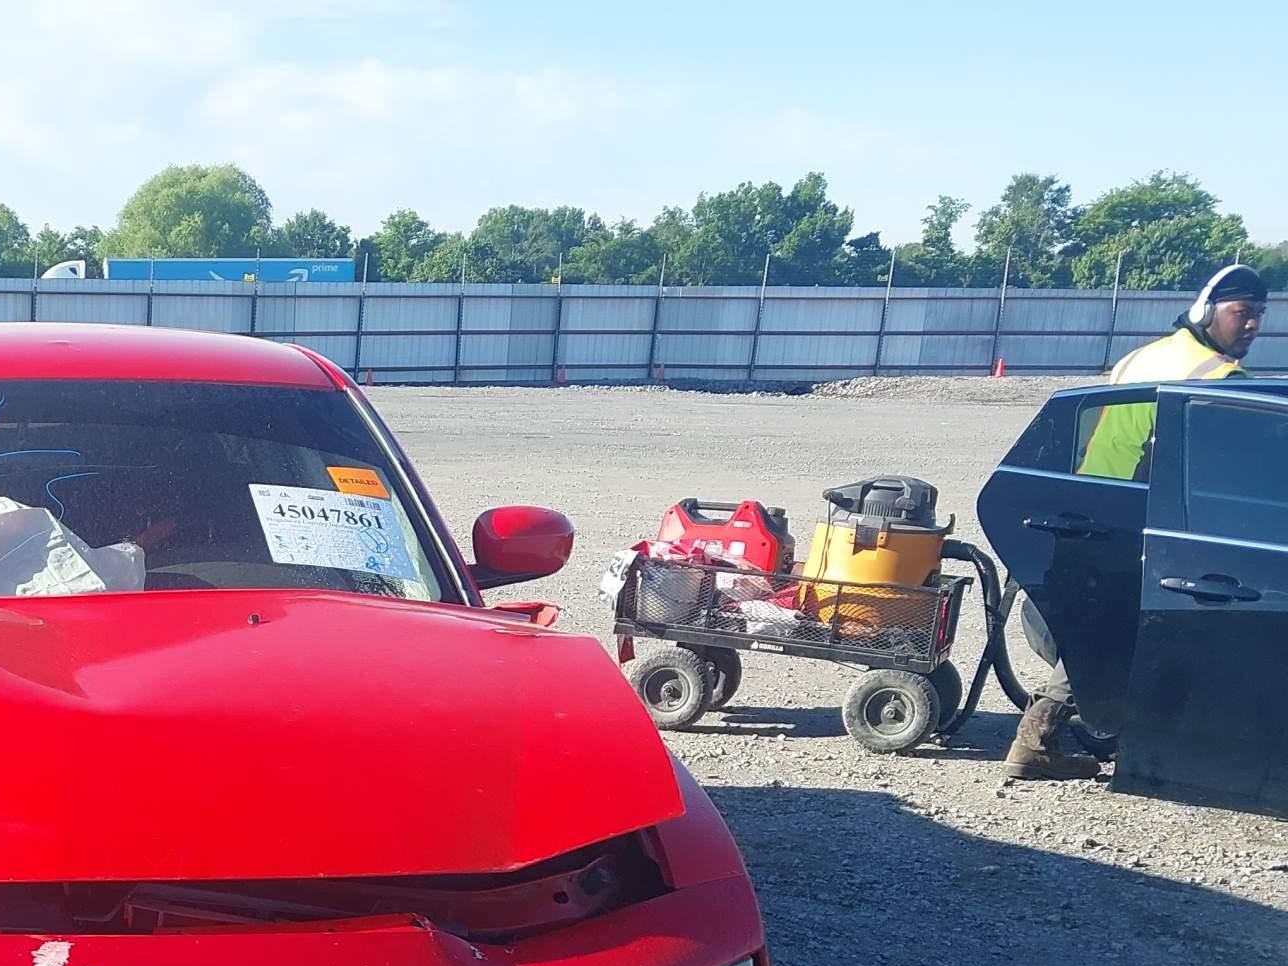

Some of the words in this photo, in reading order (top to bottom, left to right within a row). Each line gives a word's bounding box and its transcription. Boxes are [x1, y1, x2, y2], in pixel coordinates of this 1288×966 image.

[312, 264, 339, 273] prime
[338, 478, 378, 486] DETAILED
[273, 503, 384, 530] 45047861
